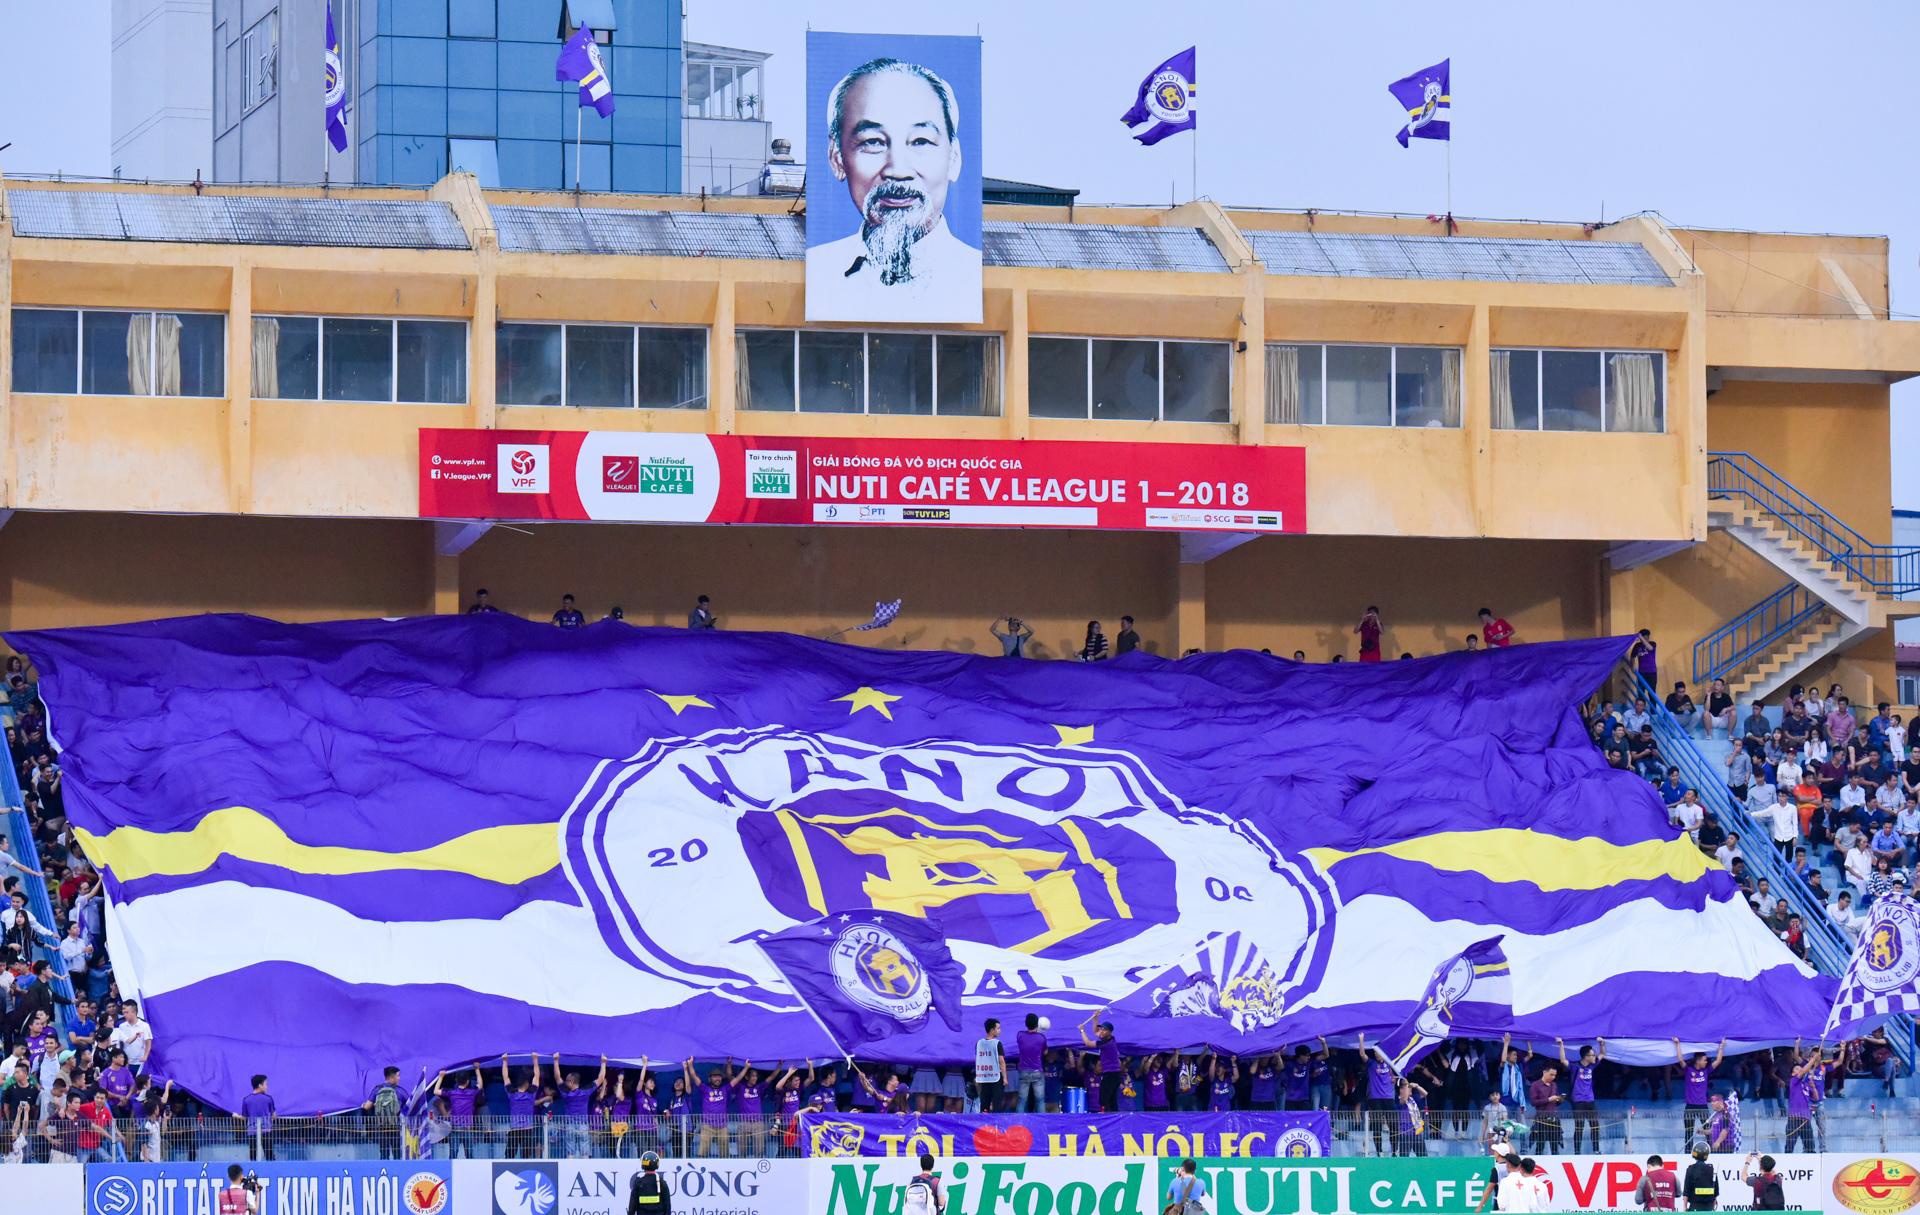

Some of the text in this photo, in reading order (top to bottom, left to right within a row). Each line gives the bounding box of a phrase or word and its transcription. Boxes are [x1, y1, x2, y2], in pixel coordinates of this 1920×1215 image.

[443, 459, 486, 467] www.vpf.vn
[812, 454, 839, 467] GIẢI
[843, 456, 881, 468] BÓNG
[927, 457, 957, 470] ĐỊCH
[960, 456, 997, 470] QUỐC
[1000, 459, 1022, 470] GIA
[641, 466, 693, 482] NUTI
[511, 478, 536, 488] VPF
[753, 475, 790, 486] NUTI
[650, 482, 683, 493] CAFÉ
[759, 485, 783, 493] CAFÉ
[814, 474, 888, 499] NUTI
[899, 472, 970, 500] CAFÉ
[980, 476, 1126, 503] V.LEAGUE
[871, 508, 885, 516] PTI
[915, 511, 950, 519] TUYLIPS
[1213, 515, 1231, 523] SCG
[647, 838, 709, 868] 20
[567, 1171, 619, 1198] AN
[142, 1171, 178, 1215] BÍT
[277, 1176, 319, 1215] KIM
[325, 1169, 360, 1215] HÀ
[1369, 1173, 1486, 1208] CAFÉ
